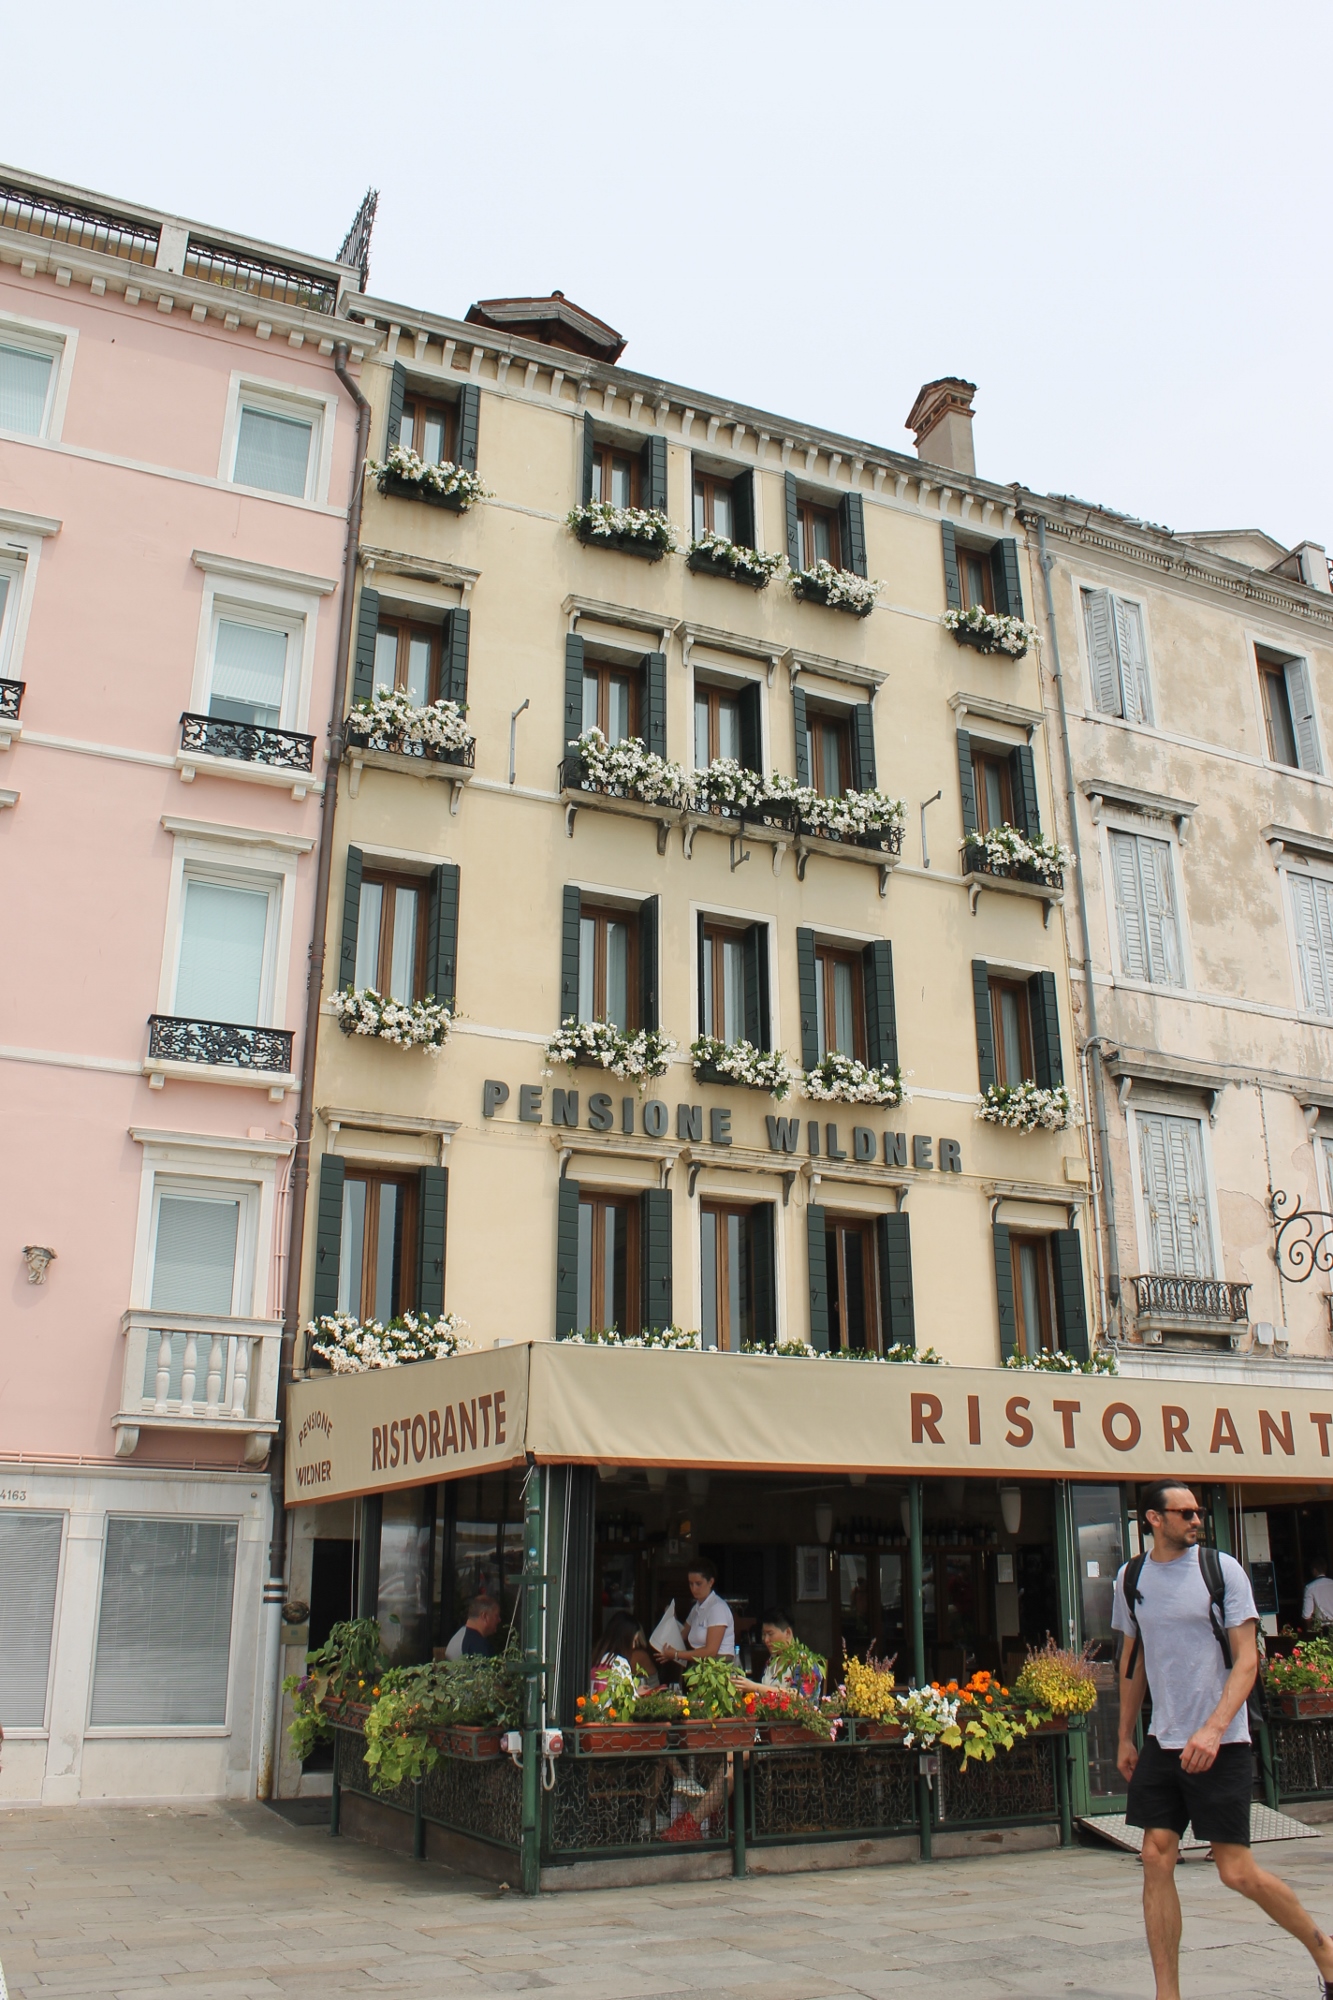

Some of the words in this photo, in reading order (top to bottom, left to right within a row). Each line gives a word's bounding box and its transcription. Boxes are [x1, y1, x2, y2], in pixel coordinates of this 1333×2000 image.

[484, 1079, 732, 1145] PENSIONE
[765, 1115, 962, 1173] WILDNER
[298, 1410, 333, 1448] PENSIONE
[372, 1390, 506, 1471] RISTORANTE
[910, 1392, 1333, 1457] RISTORANT
[0, 1489, 27, 1501] 4163
[296, 1460, 331, 1486] WILDNER
